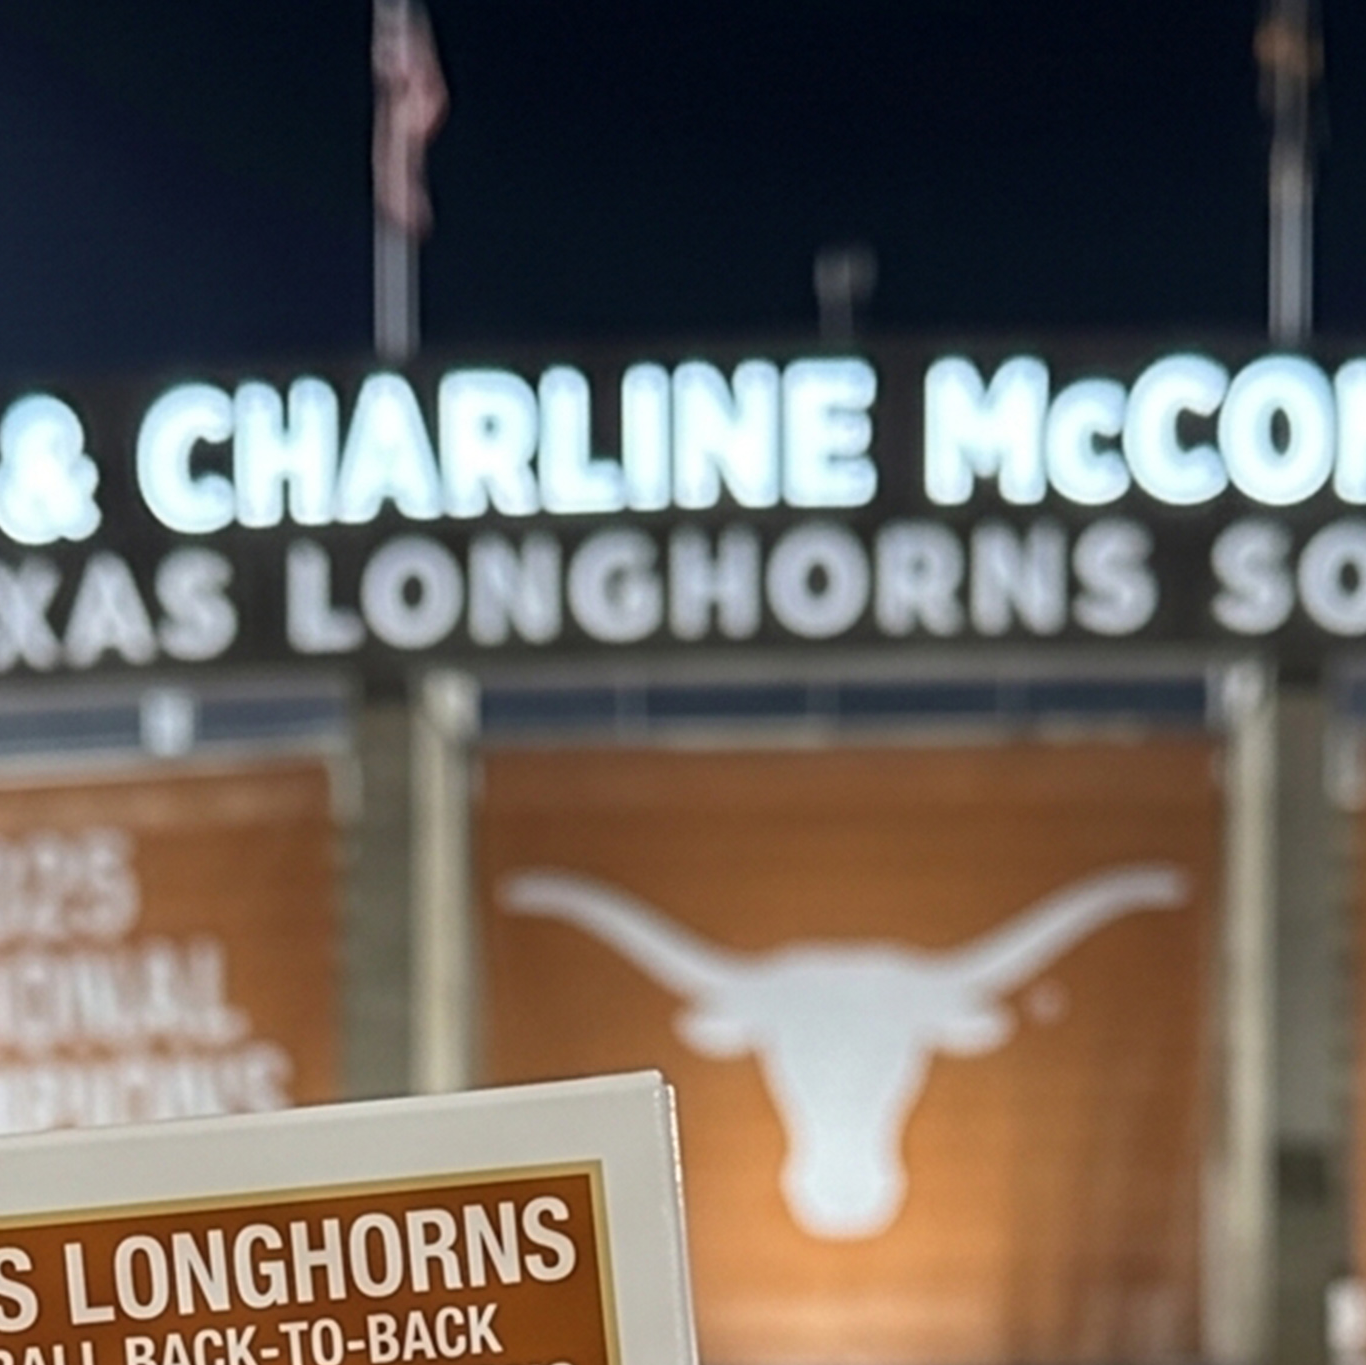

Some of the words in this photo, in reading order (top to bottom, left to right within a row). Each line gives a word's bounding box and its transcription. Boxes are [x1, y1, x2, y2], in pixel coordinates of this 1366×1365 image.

[136, 359, 876, 534] CHARLINE
[287, 520, 1158, 655] LONGHORNS
[64, 1194, 578, 1326] LONGHORNS
